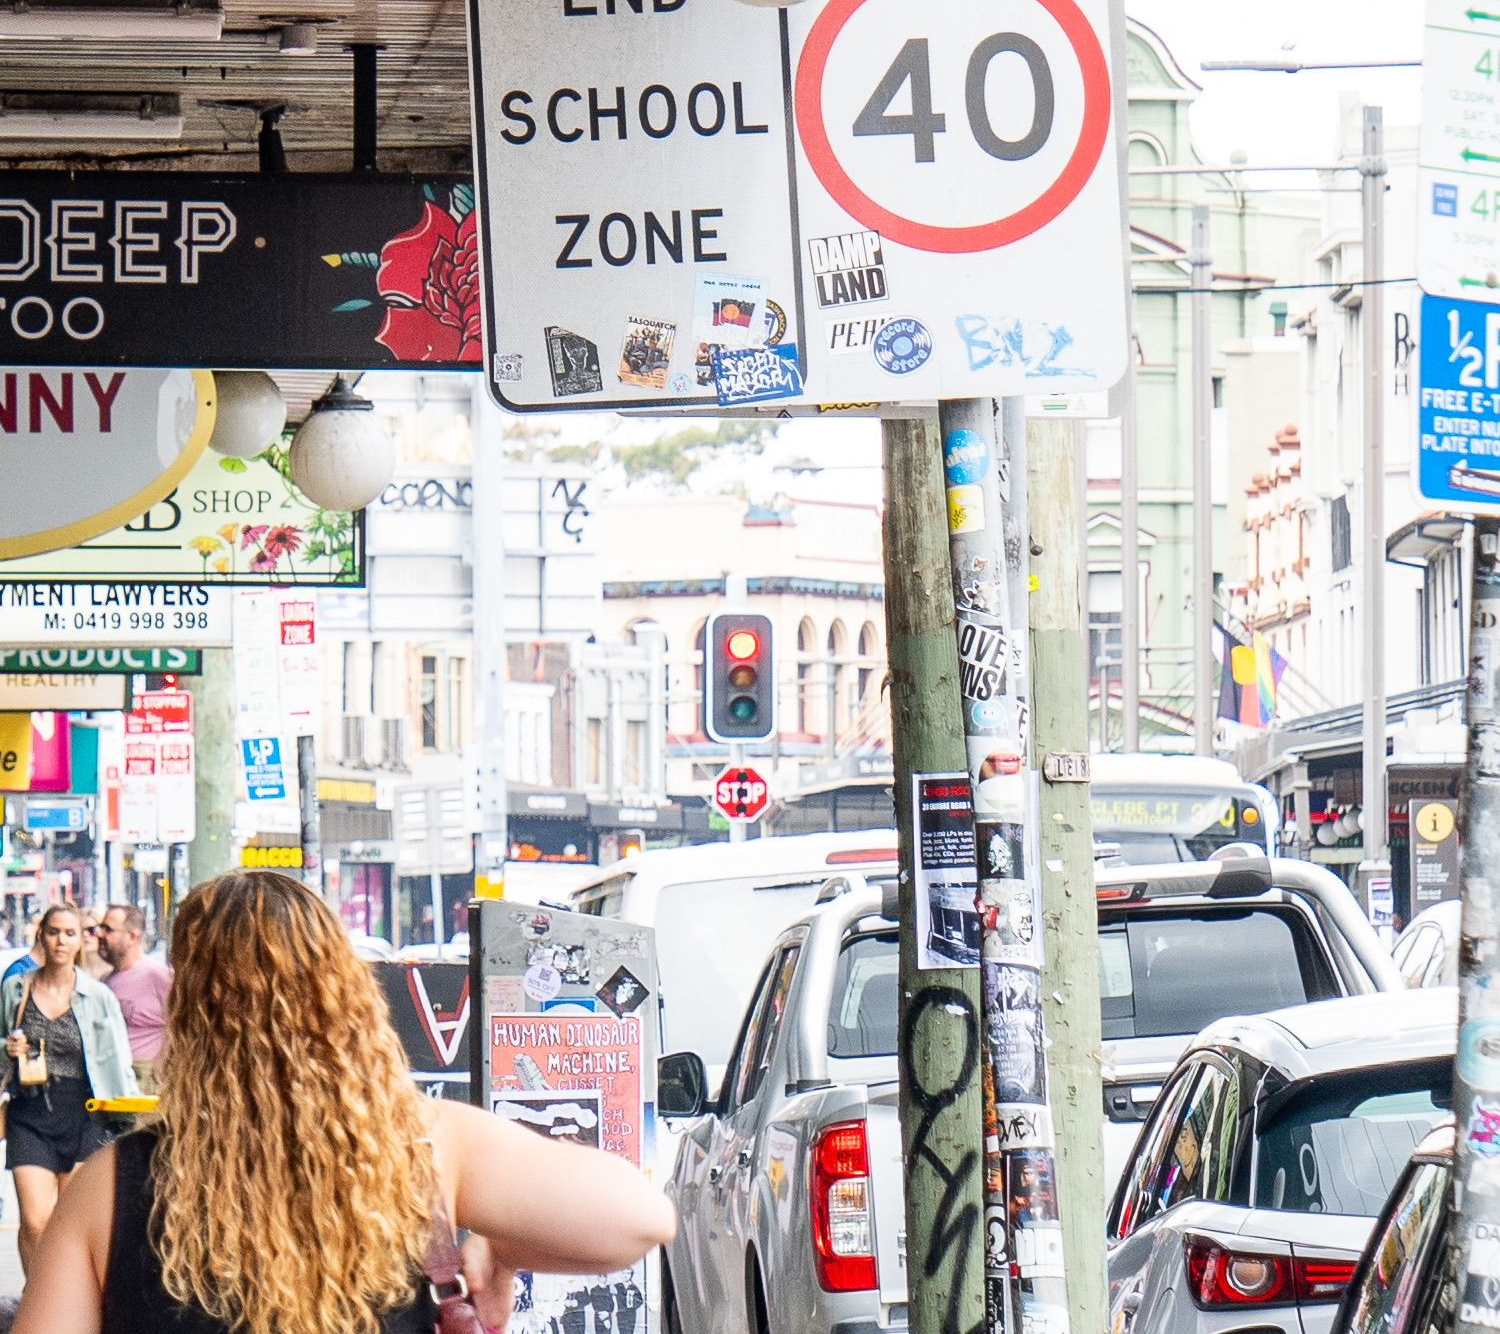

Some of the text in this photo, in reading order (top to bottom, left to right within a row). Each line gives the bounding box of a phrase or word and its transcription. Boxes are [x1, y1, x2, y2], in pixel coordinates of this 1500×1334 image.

[852, 31, 1055, 163] 40
[500, 81, 769, 146] SCHOOL
[555, 208, 728, 269] ZONE
[809, 231, 883, 274] DAMP
[815, 267, 886, 307] LAND
[628, 316, 677, 331] SASQUATCH
[877, 321, 916, 346] record
[1421, 387, 1469, 412] FREE
[1433, 416, 1480, 436] ENTER
[1421, 433, 1469, 454] PLATE
[1470, 439, 1500, 458] INTO
[193, 488, 272, 515] SHOP
[90, 584, 210, 607] LAWYERS
[43, 612, 209, 630] M: 0419 998 398
[283, 624, 313, 644] ZONE
[960, 623, 1008, 670] OVE
[716, 782, 766, 805] STOP
[1090, 800, 1150, 816] GLEBE
[493, 1021, 640, 1048] HUMAN DINOSAUR
[547, 1050, 636, 1076] MACHINE,
